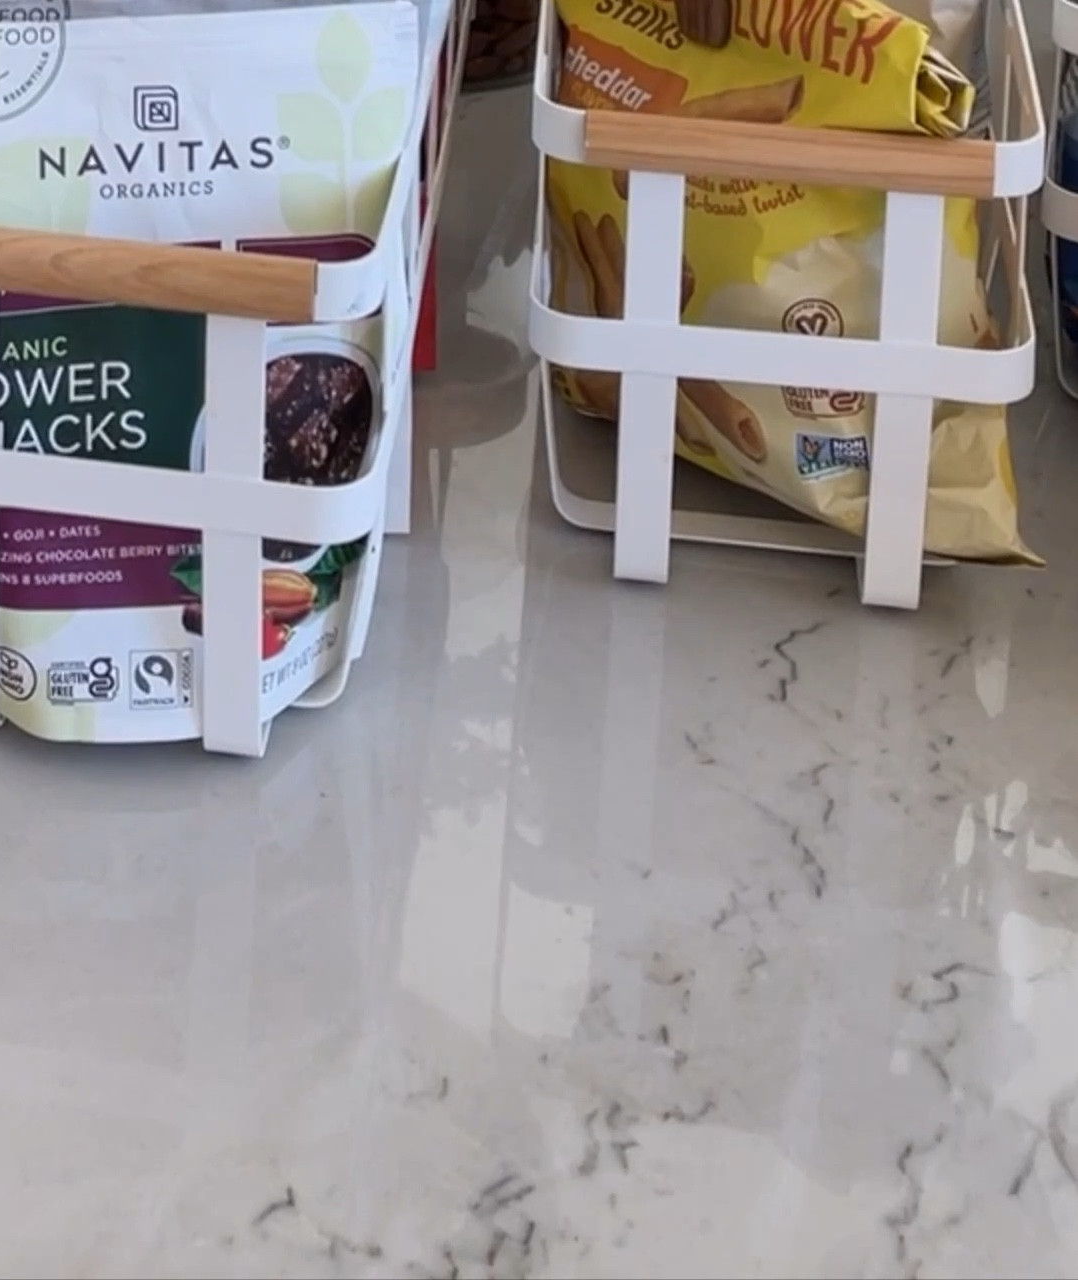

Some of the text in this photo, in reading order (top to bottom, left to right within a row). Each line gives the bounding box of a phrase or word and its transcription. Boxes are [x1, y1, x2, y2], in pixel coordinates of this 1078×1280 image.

[3, 51, 50, 105] ESSENTIALS
[565, 45, 653, 110] cheddar
[38, 136, 275, 181] NAVITAS
[98, 180, 215, 200] ORGANICS
[13, 524, 101, 542] GOJI DATES
[35, 545, 116, 564] CHOCOLATE
[119, 545, 162, 559] BERRY
[34, 570, 123, 585] SUPERFOODS
[50, 671, 90, 685] GLUTEN
[50, 685, 74, 698] FREE
